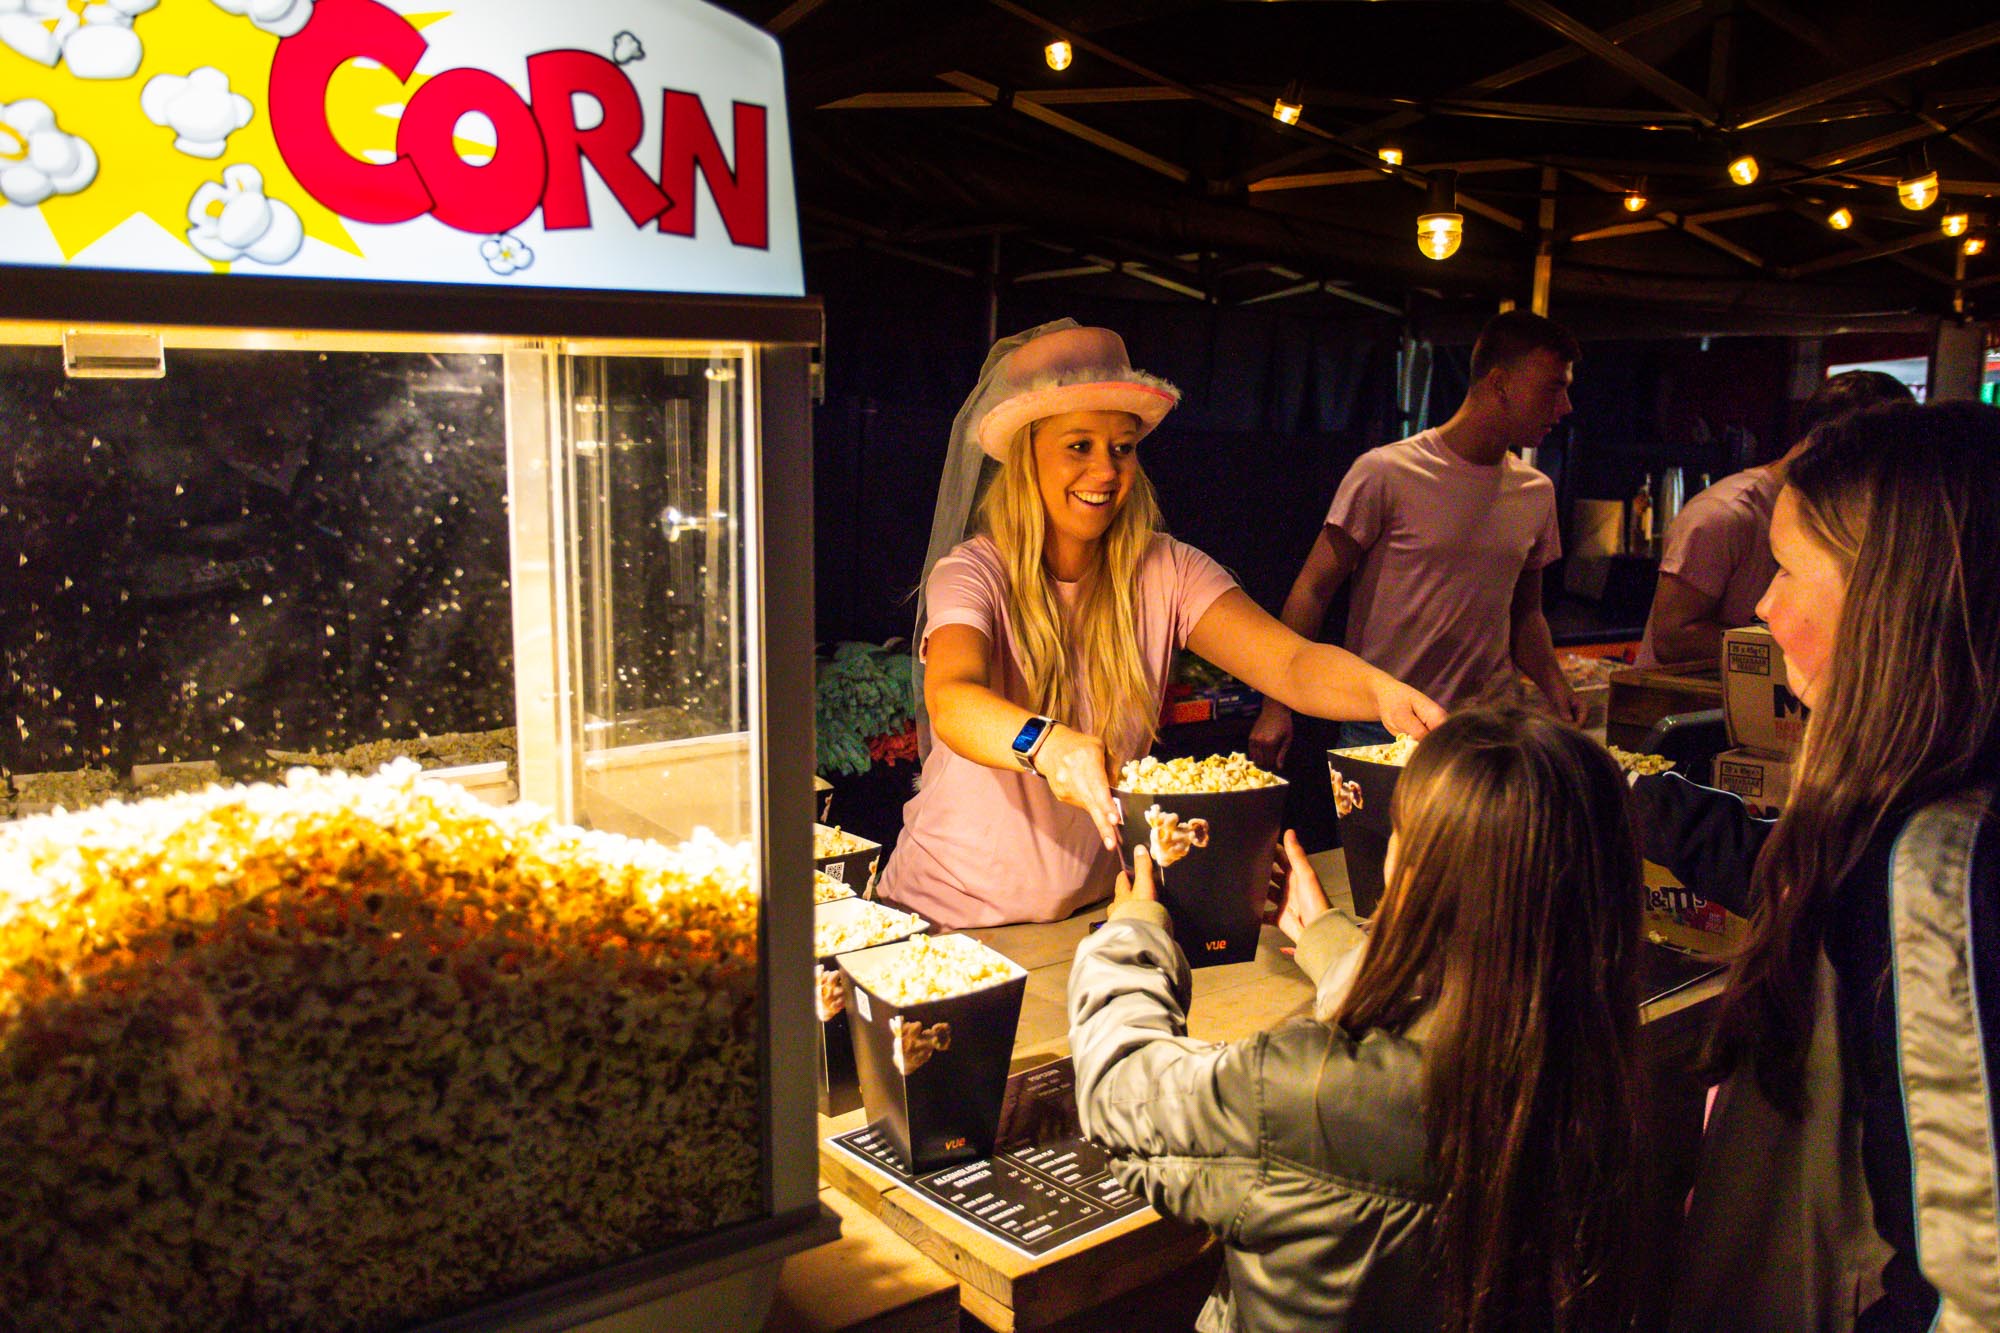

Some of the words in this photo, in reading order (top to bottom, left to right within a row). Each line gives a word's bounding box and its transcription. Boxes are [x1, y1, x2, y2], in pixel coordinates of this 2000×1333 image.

[268, 0, 770, 251] CORN
[1205, 940, 1227, 951] vue
[945, 1137, 966, 1151] vue
